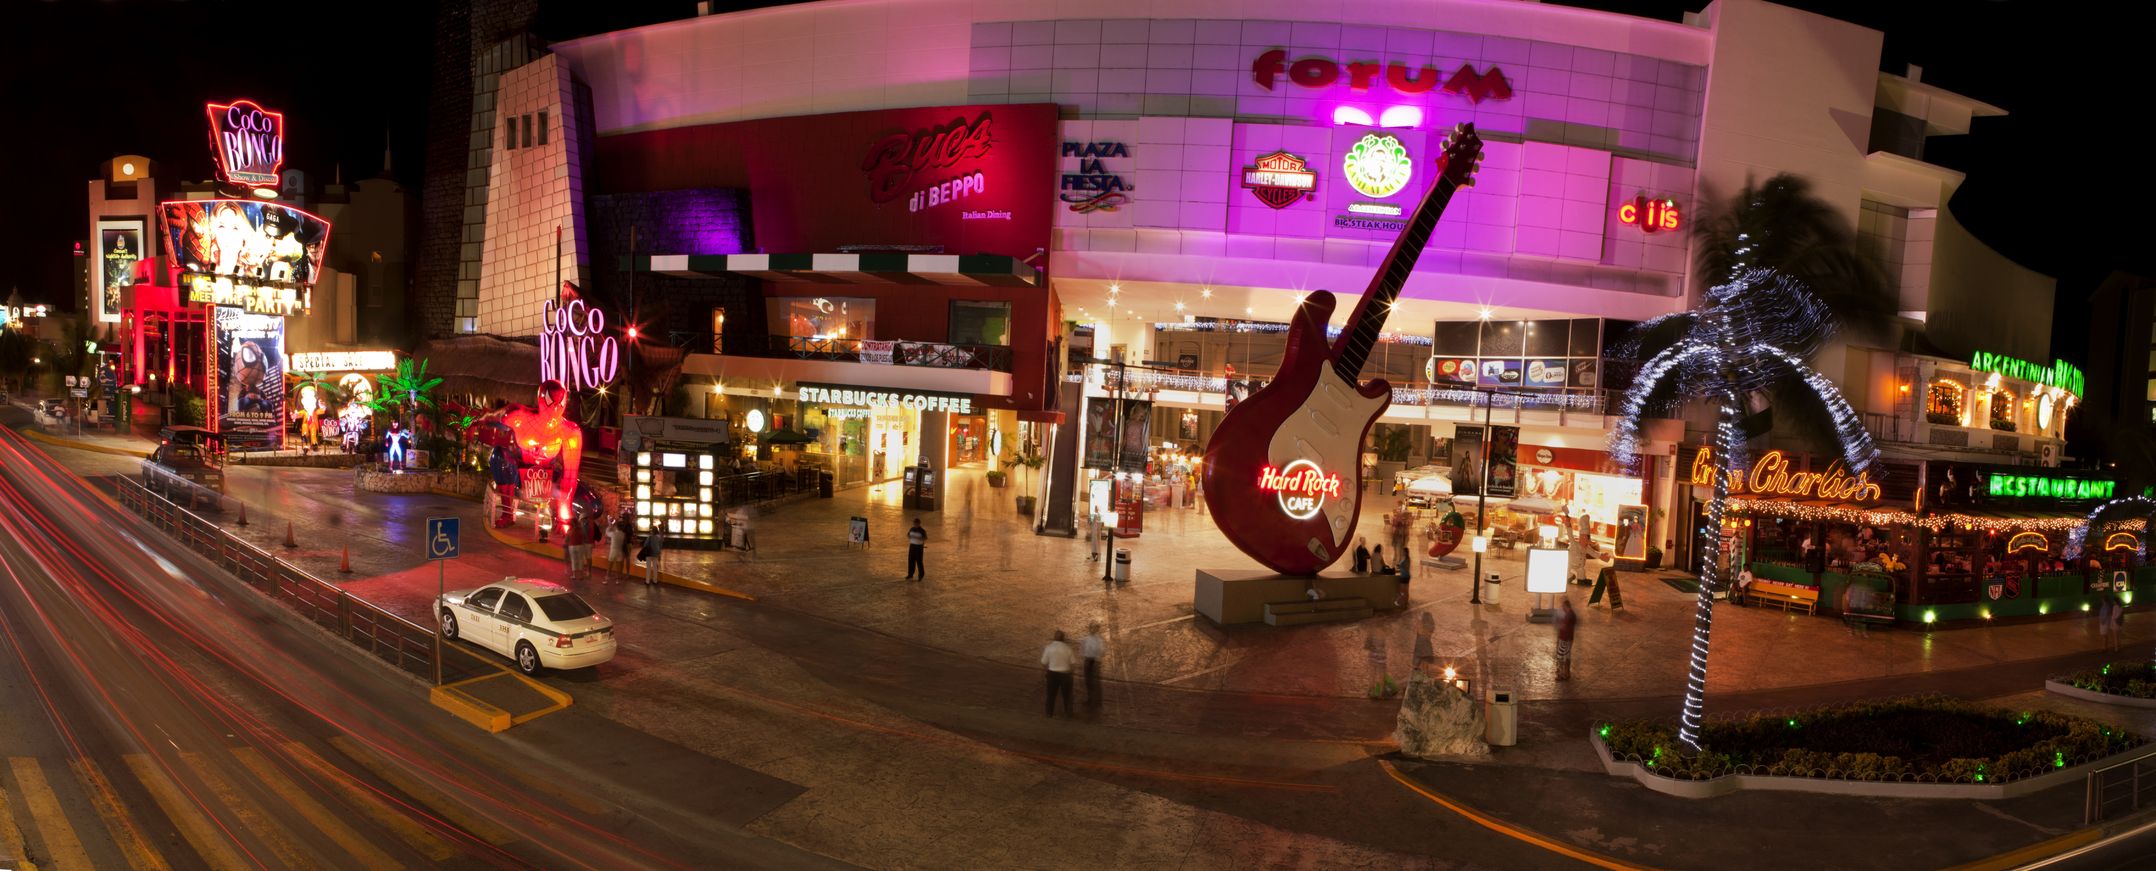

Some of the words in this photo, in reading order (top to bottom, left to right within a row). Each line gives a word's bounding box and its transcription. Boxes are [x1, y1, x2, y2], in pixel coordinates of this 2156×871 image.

[224, 127, 282, 171] BONGO
[1062, 142, 1129, 158] PLAZA
[1080, 158, 1104, 174] LA
[1263, 156, 1296, 171] MOTOR
[1062, 174, 1125, 191] FIESTA
[909, 191, 925, 213] di
[929, 172, 984, 207] BEPPO
[266, 212, 280, 223] GAGA
[962, 211, 986, 219] Italian
[987, 210, 1011, 220] Dining
[1351, 220, 1381, 230] STEAK
[299, 355, 335, 369] SPECIAL
[540, 331, 619, 392] BONGO
[1971, 350, 2054, 387] ARGENTINIAN
[799, 387, 899, 408] STARBUCKS
[902, 394, 971, 414] COFFEE
[828, 408, 856, 420] STARBUCKS
[1260, 467, 1303, 491] Hard
[1302, 469, 1339, 497] Rock
